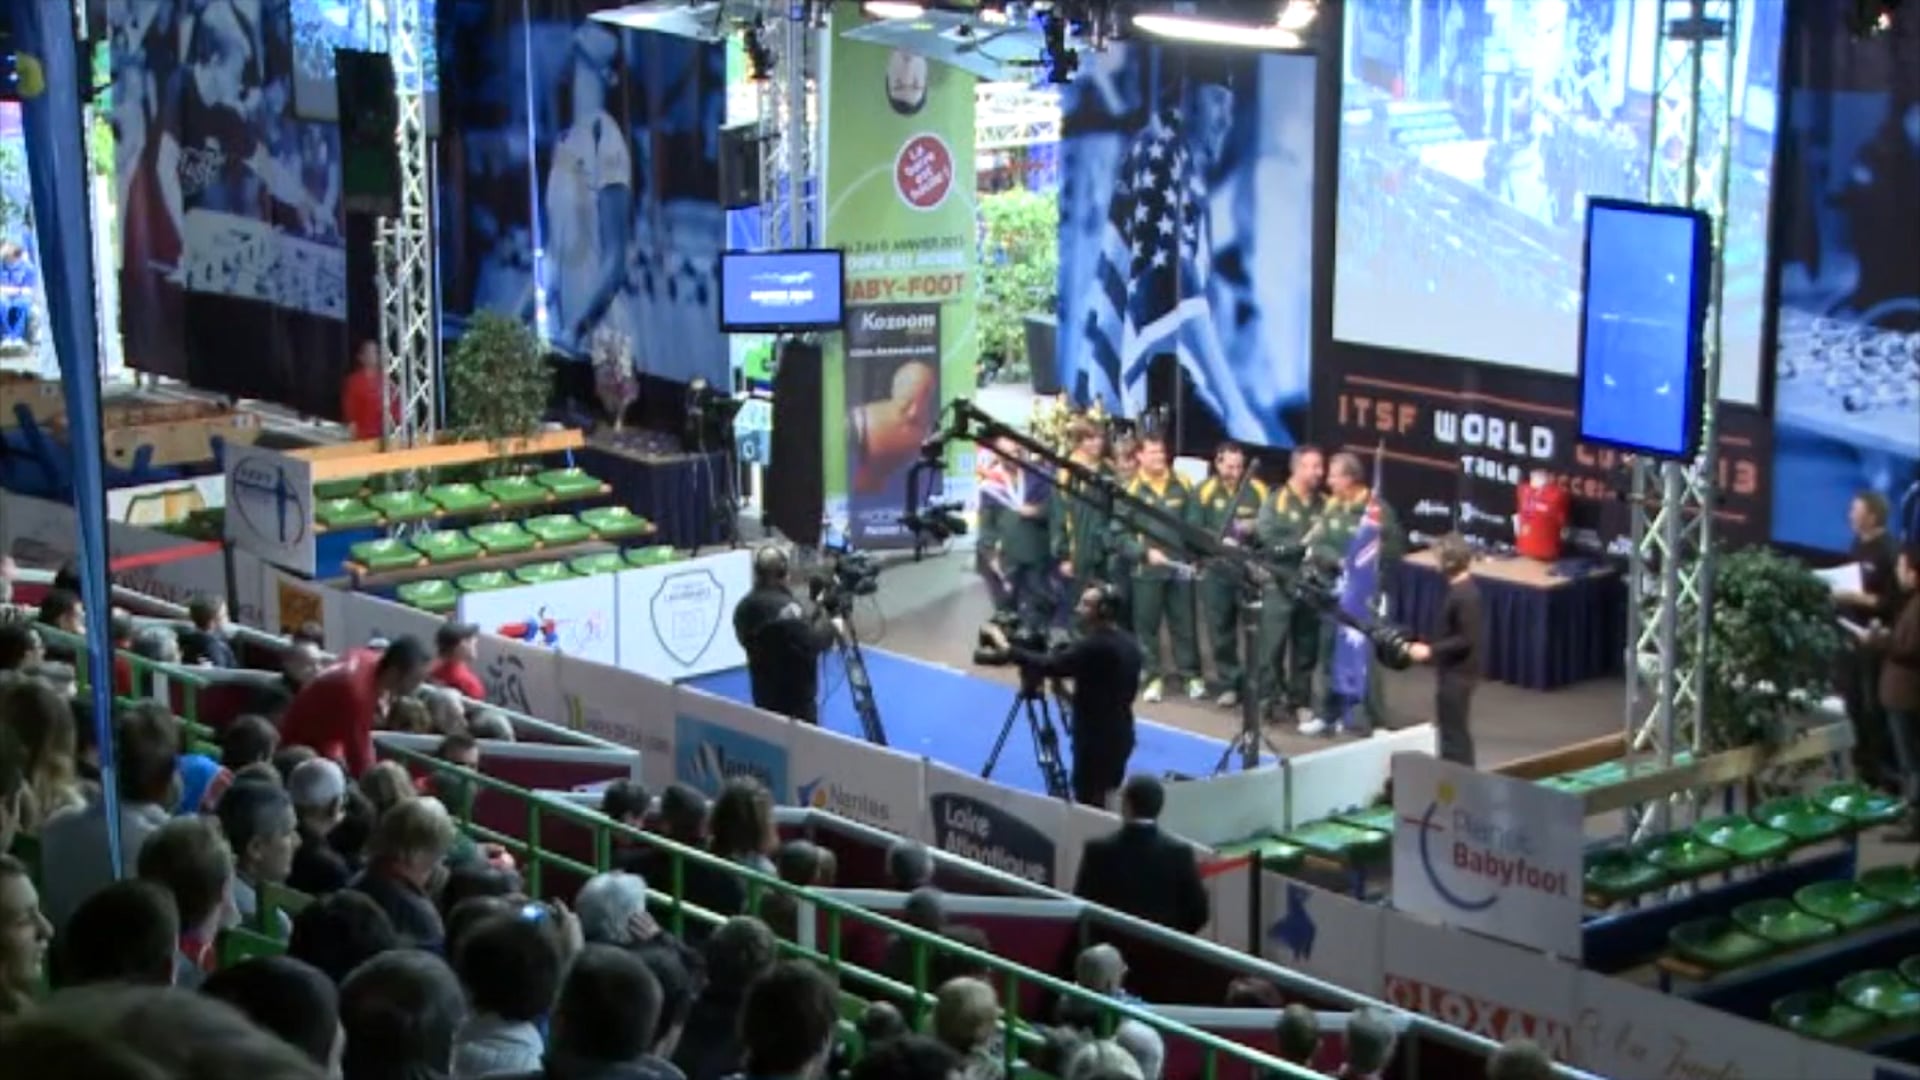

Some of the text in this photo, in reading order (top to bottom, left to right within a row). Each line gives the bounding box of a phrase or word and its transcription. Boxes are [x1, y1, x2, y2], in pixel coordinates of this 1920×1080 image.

[847, 274, 964, 299] ABY-FOOT
[861, 311, 936, 331] Kozoom
[1338, 395, 1417, 433] ITSF
[1433, 410, 1554, 458] WORLD
[945, 801, 990, 837] Loire
[1453, 841, 1568, 896] Babyfoot
